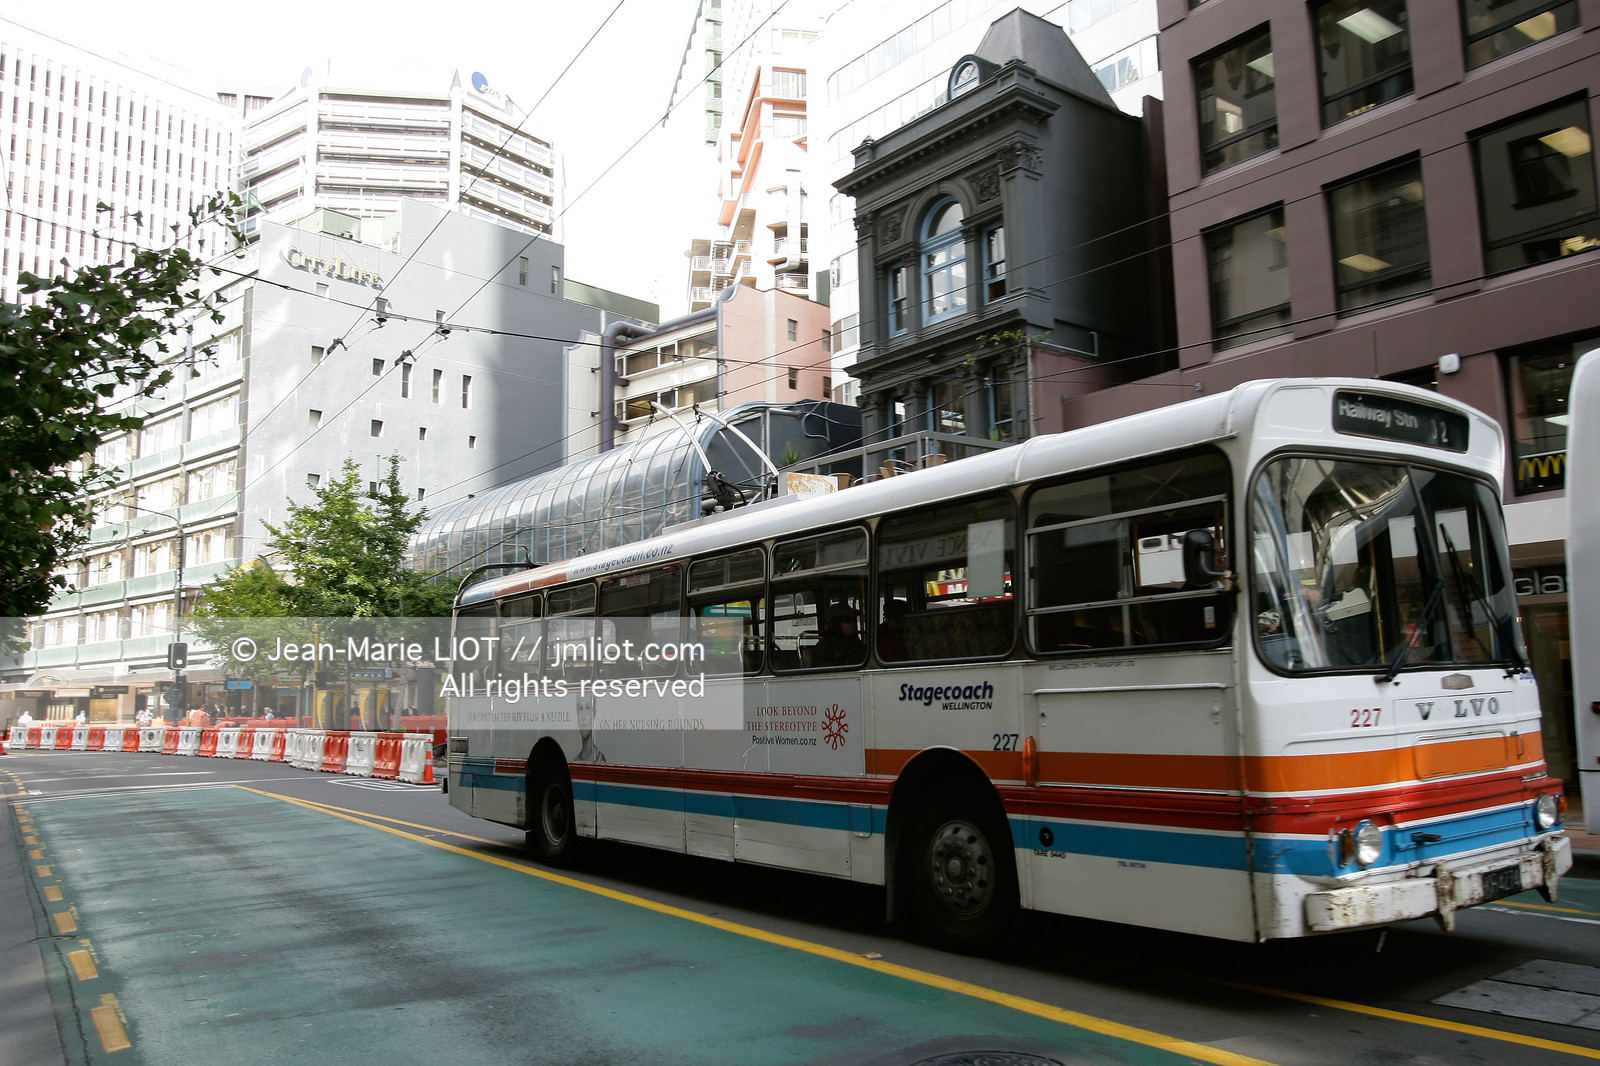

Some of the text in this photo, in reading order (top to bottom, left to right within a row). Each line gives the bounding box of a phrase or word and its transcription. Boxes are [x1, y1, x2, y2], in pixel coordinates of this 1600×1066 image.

[1338, 396, 1419, 428] Railway Stn
[899, 681, 994, 706] Stagecoach
[756, 706, 817, 716] LOOK BEYOND
[942, 702, 993, 710] WELLINGTON
[746, 721, 817, 732] THE STEREOTYPE
[1350, 708, 1382, 727] 227
[993, 733, 1019, 751] 227
